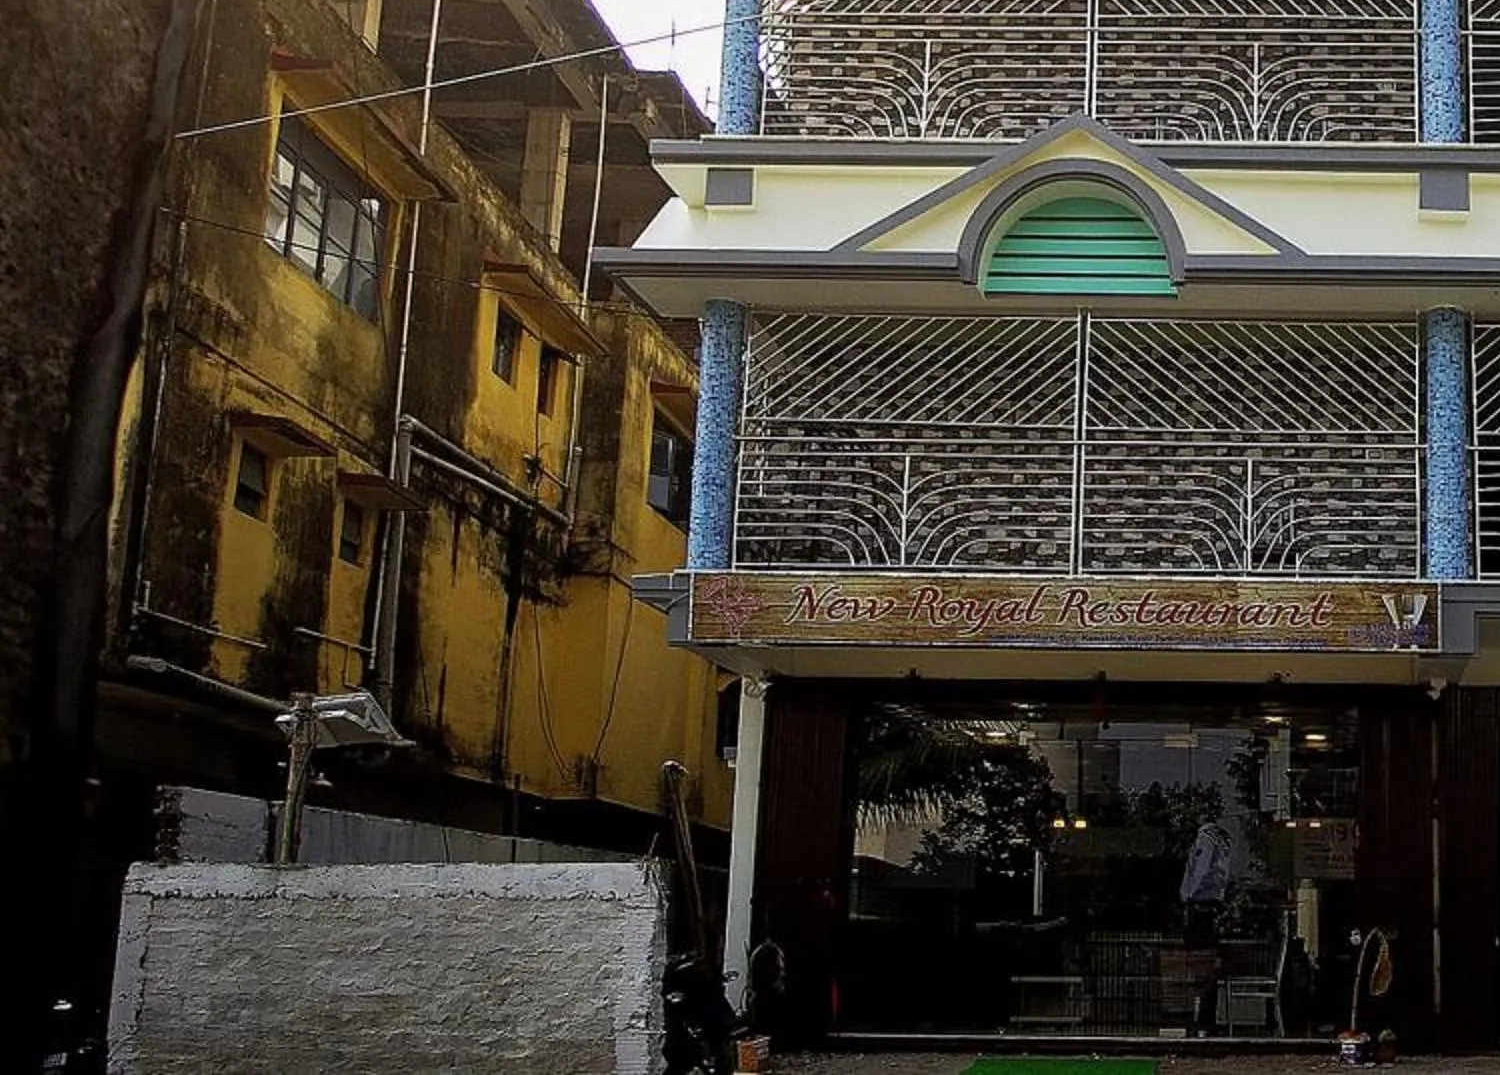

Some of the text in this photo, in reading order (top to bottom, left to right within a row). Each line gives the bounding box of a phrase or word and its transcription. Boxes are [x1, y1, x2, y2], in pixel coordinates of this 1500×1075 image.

[783, 582, 1337, 638] New Royal Restaurant
